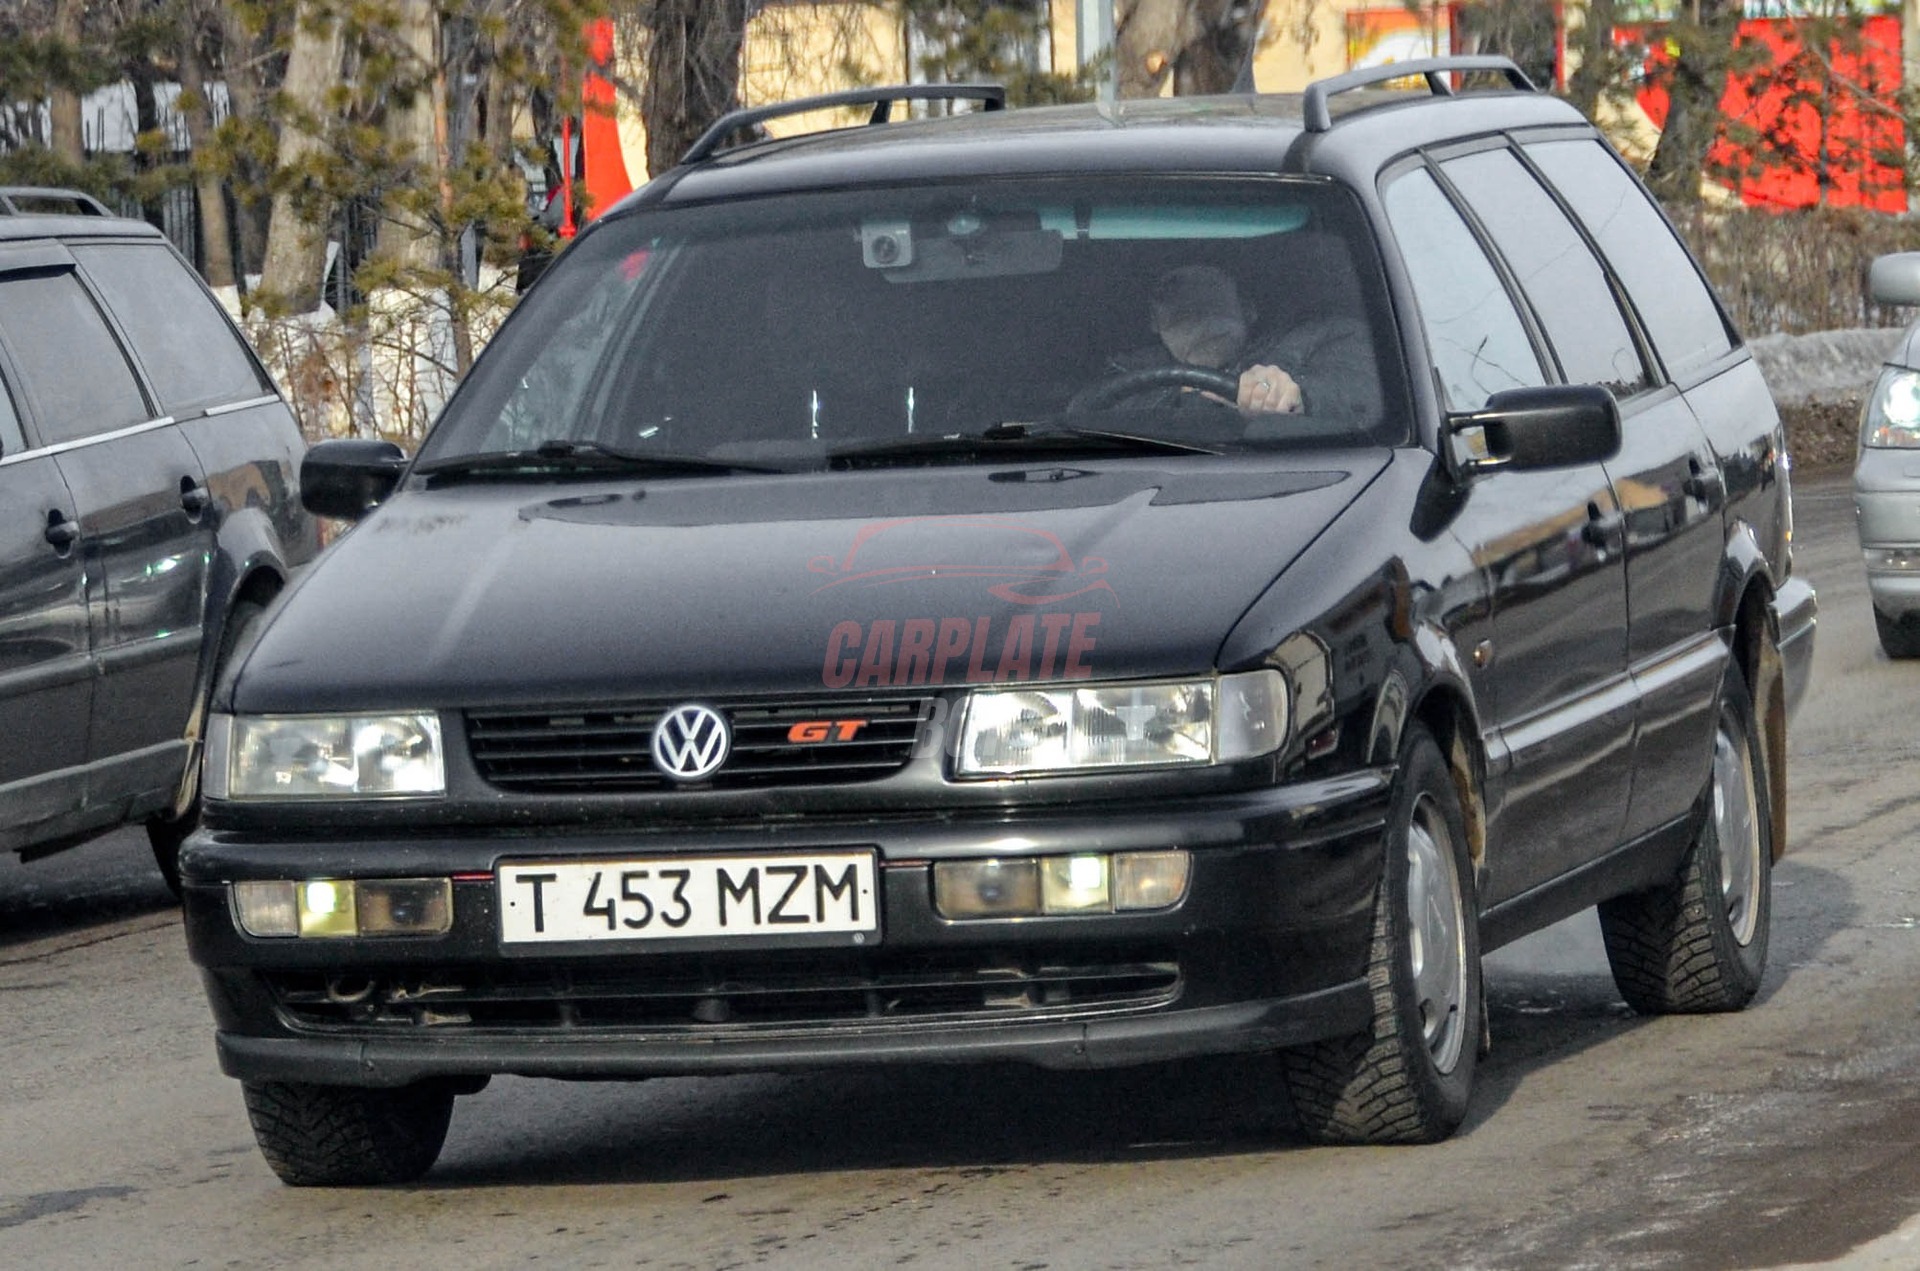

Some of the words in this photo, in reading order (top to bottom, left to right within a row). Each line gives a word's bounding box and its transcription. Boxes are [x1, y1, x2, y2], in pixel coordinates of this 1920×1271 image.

[656, 706, 726, 776] VW
[787, 719, 868, 743] GT
[515, 873, 557, 933] T
[583, 869, 692, 930] 453
[716, 863, 860, 926] MZM
